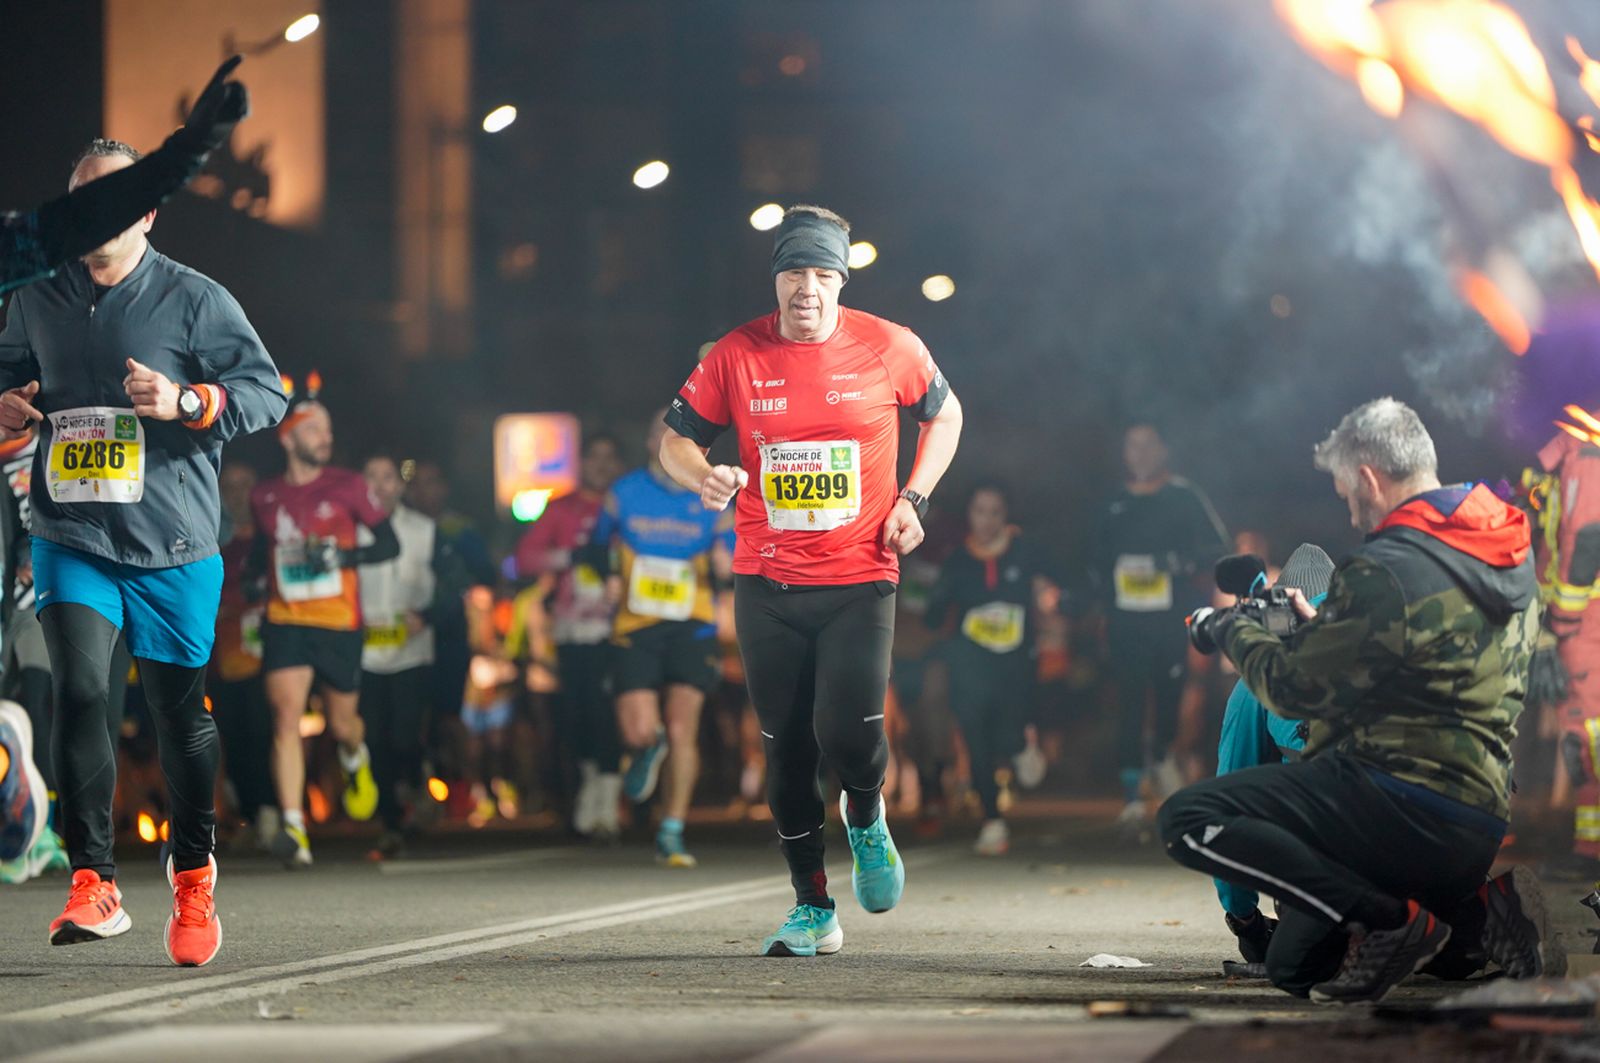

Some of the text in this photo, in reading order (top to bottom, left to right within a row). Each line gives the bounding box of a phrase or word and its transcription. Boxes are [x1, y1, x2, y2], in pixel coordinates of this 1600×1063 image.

[750, 397, 787, 412] BTG
[94, 417, 106, 427] DE
[63, 441, 125, 470] 6286
[779, 451, 809, 461] NOCHE
[810, 451, 822, 460] DE
[771, 463, 789, 473] SAN
[771, 473, 849, 500] 13299
